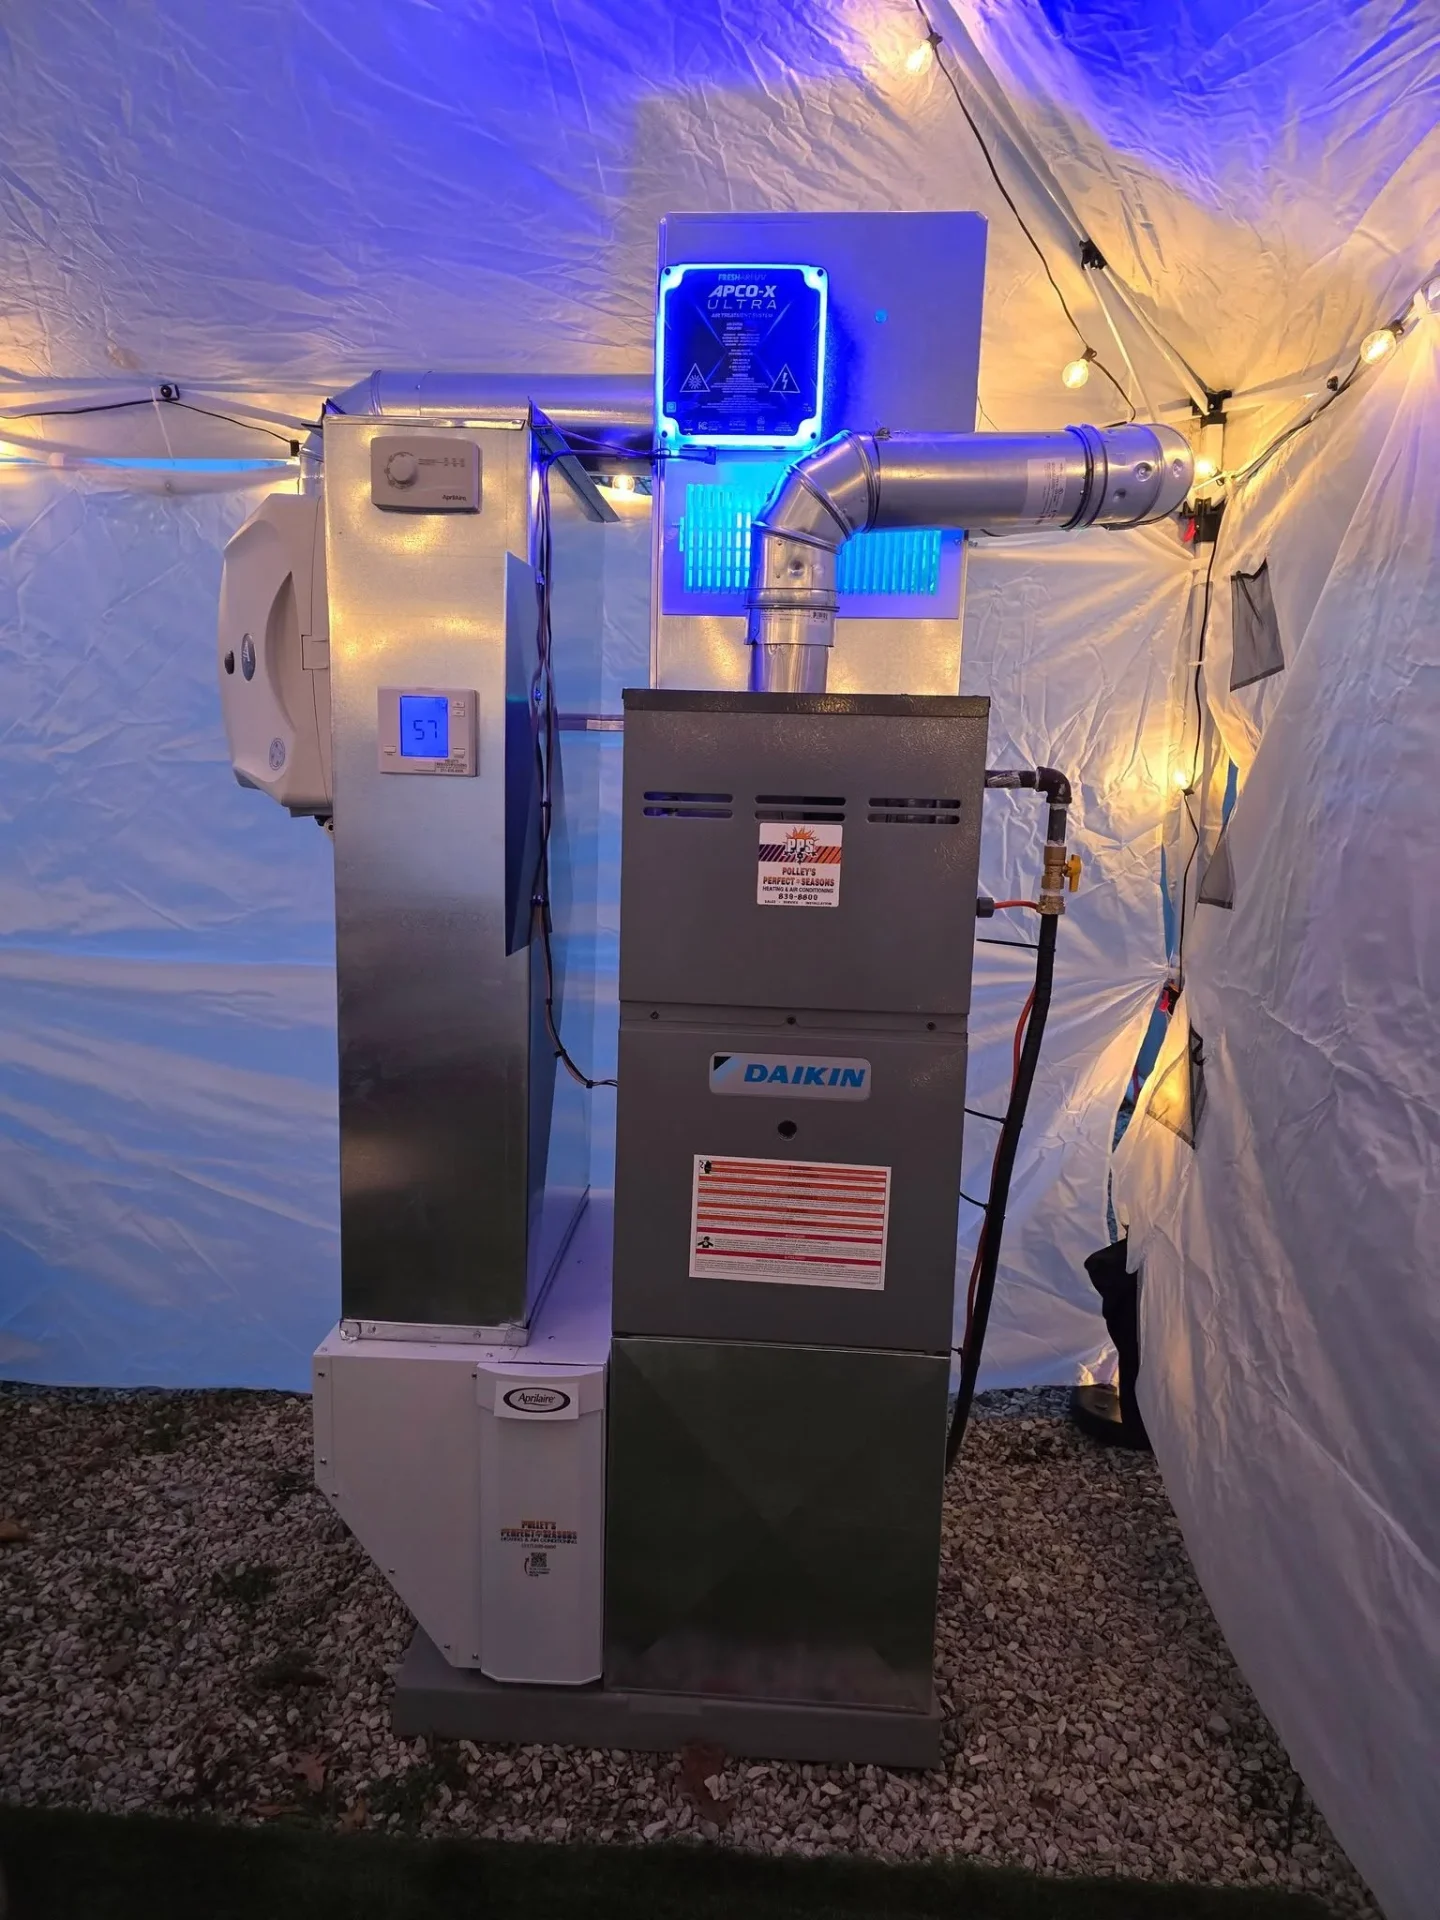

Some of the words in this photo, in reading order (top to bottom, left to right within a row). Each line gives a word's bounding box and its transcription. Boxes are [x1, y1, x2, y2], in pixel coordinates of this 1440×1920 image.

[708, 284, 777, 298] APCO-X
[707, 299, 777, 310] ULTRA
[413, 719, 438, 740] 57
[786, 838, 815, 853] PPS
[782, 867, 816, 876] POLLEY'S
[763, 876, 796, 885] PERFECT
[801, 878, 835, 887] SEASONS
[744, 1064, 866, 1088] DAIKIN
[518, 1392, 555, 1405] Aprilaire
